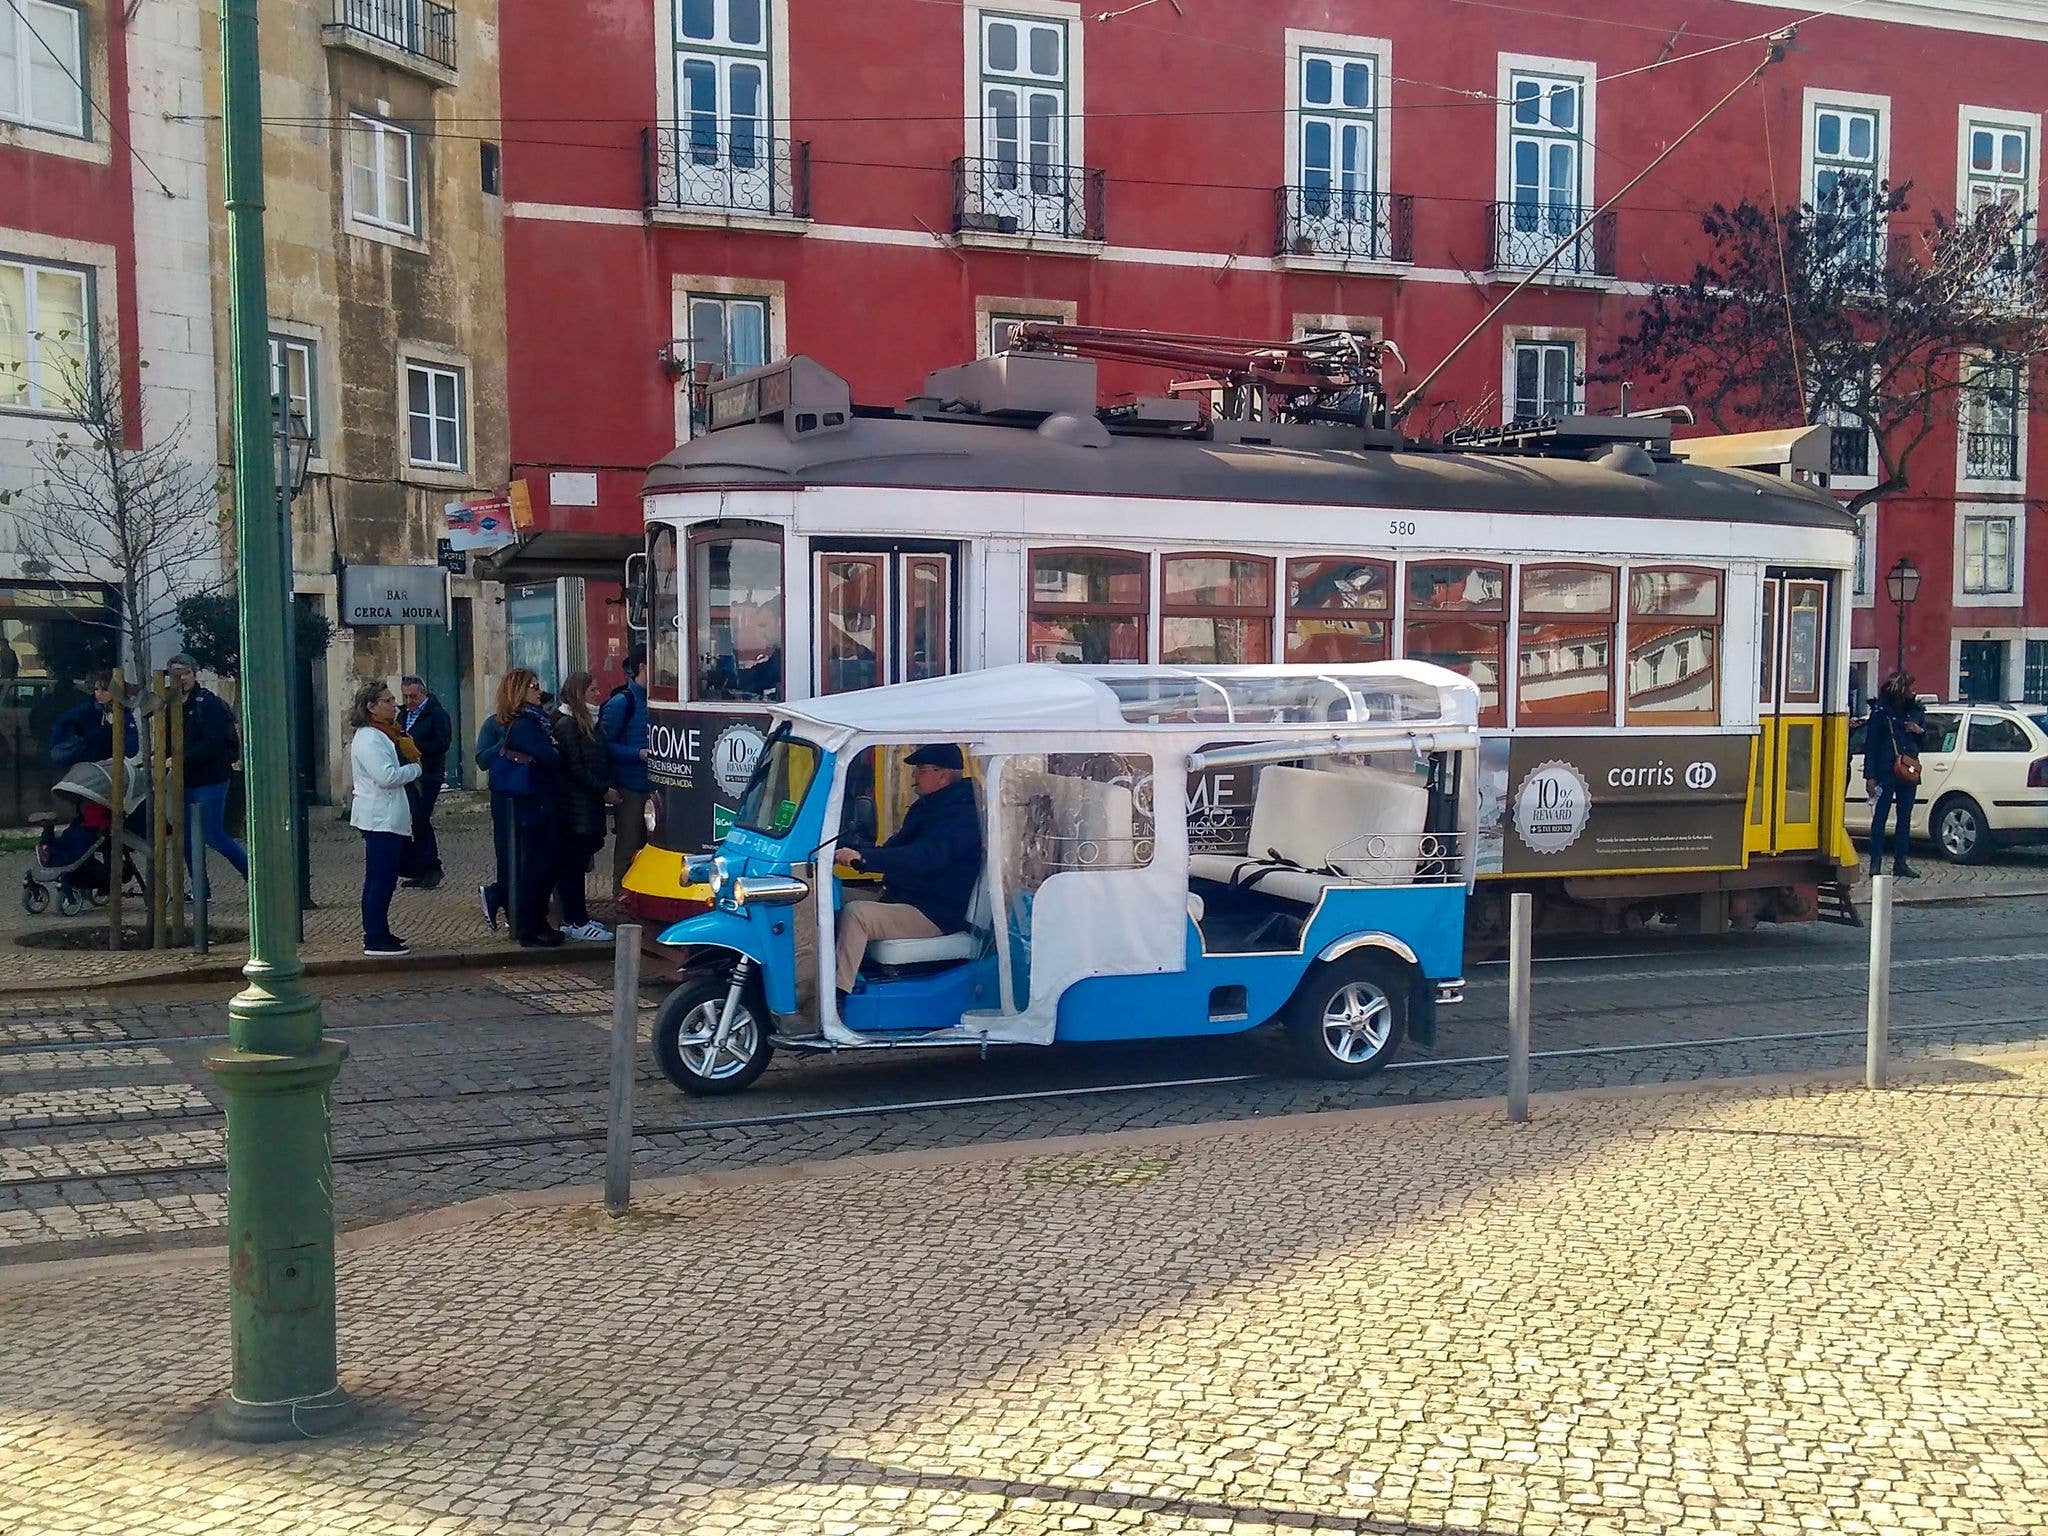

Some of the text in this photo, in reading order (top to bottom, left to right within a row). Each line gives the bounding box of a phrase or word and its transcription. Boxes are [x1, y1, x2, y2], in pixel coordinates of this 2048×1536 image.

[1389, 521, 1415, 535] 580
[386, 590, 408, 600] BAR
[354, 607, 441, 618] CERCA MOURA
[727, 762, 756, 773] REWAR
[1608, 760, 1675, 787] carris
[1533, 809, 1572, 821] REWARD
